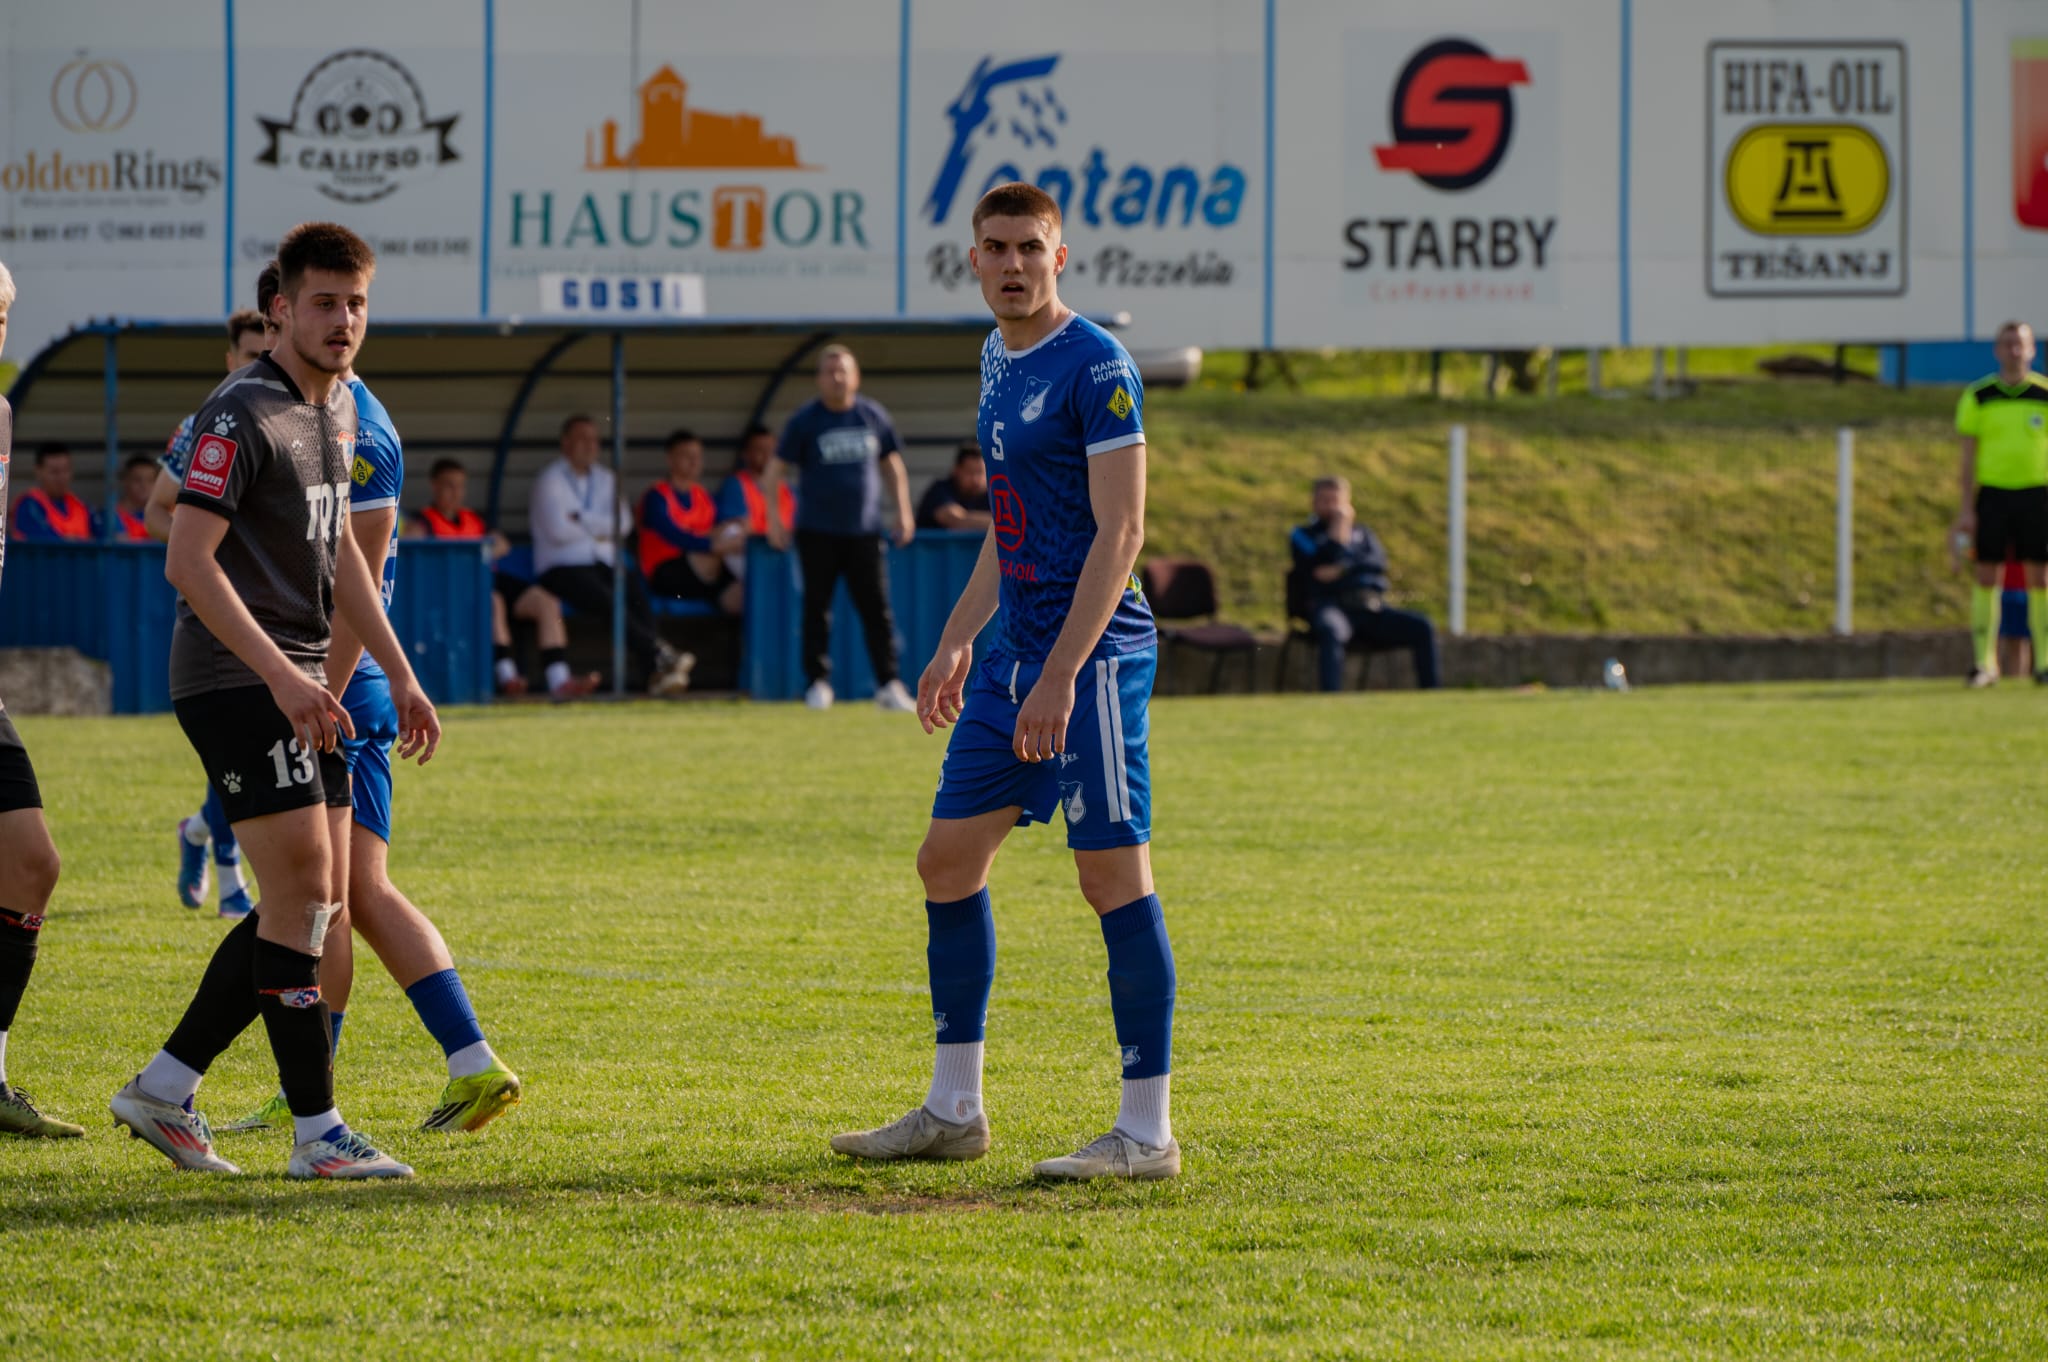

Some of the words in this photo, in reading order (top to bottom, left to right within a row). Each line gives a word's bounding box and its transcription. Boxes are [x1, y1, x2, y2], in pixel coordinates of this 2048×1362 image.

[1722, 60, 1893, 115] HIFA-OIL
[0, 149, 221, 202] oldenRings
[299, 147, 420, 171] CALIPSO
[507, 187, 870, 251] HAUSTOR
[1342, 217, 1555, 271] STARBY
[1721, 244, 1892, 279] TEŠANJ
[562, 279, 682, 312] GOSTI
[356, 437, 378, 447] MEL
[991, 421, 1004, 461] 5
[267, 737, 314, 788] 13
